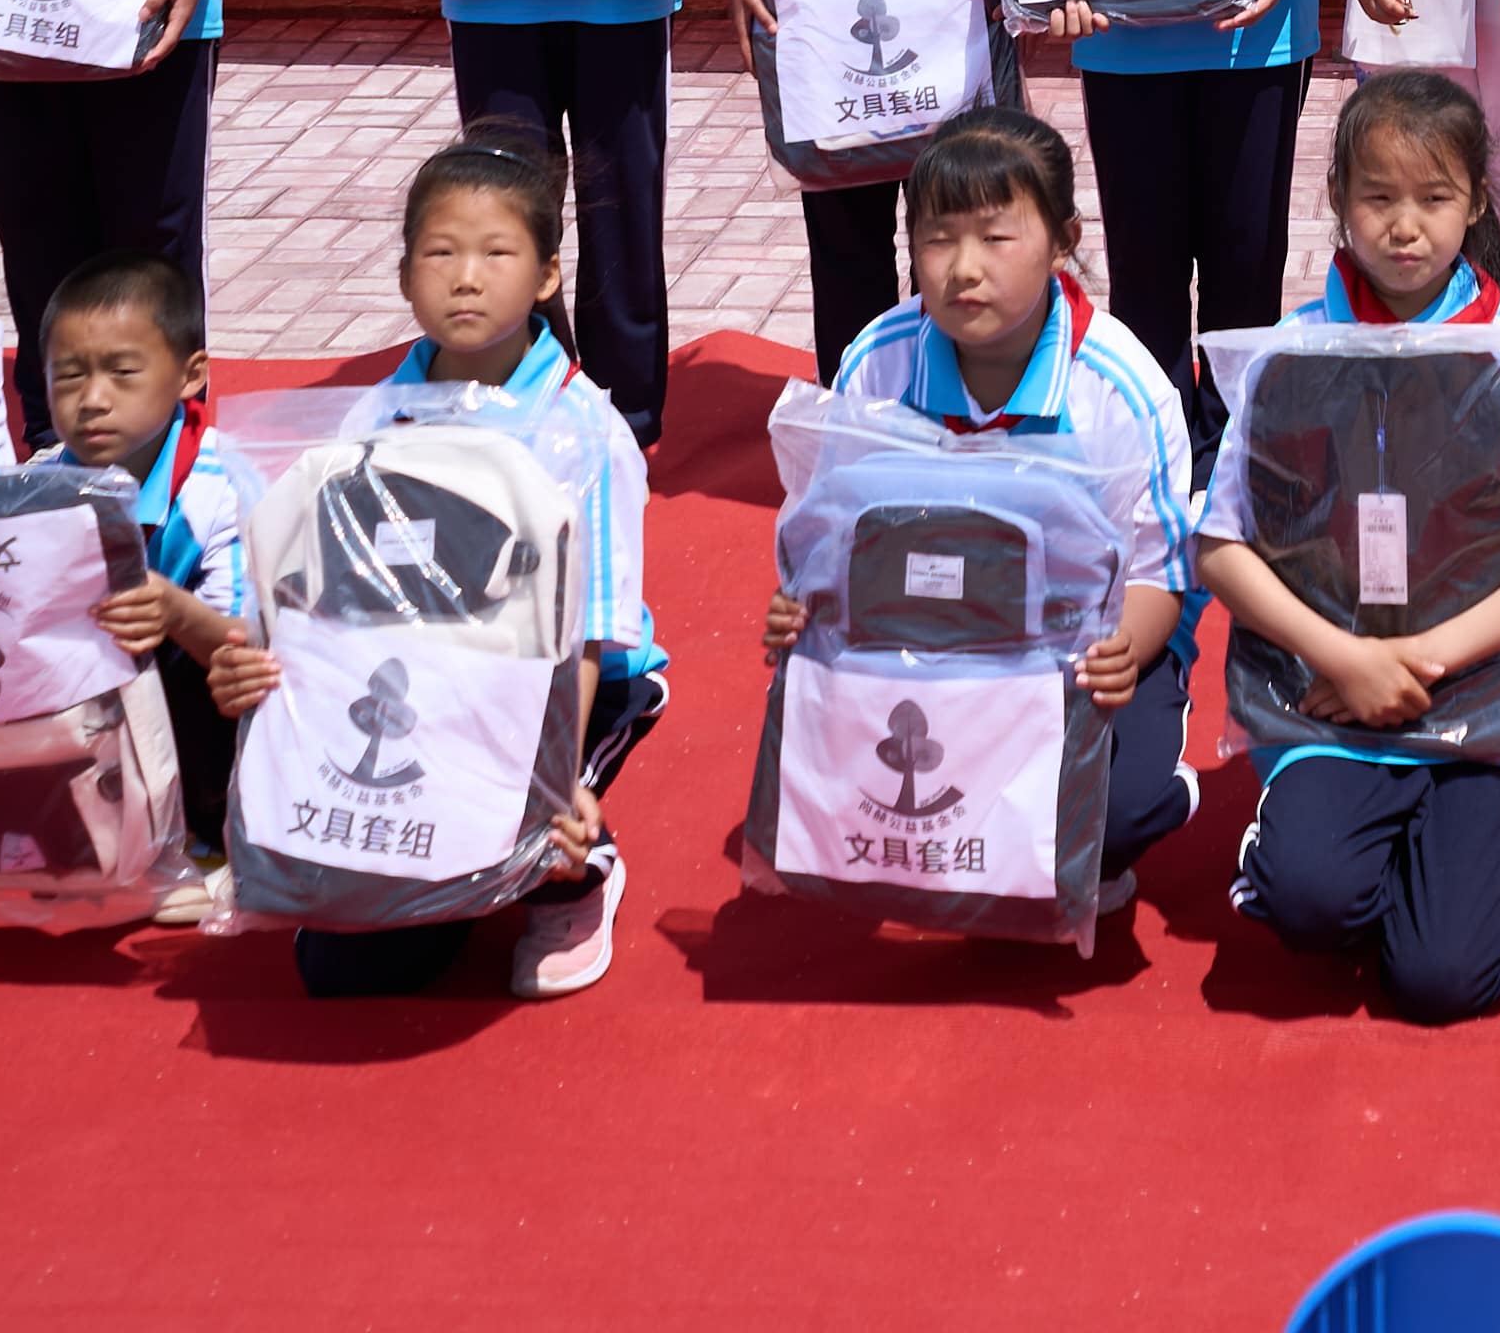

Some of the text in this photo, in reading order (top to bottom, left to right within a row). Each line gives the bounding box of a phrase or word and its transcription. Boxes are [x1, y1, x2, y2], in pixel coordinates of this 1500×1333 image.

[835, 85, 941, 123] 文具套组
[317, 763, 423, 806] 尚赫公益基金会
[287, 799, 436, 860] 文具套组
[858, 800, 966, 832] 尚赫公益基金会
[844, 833, 987, 875] 文具套组
